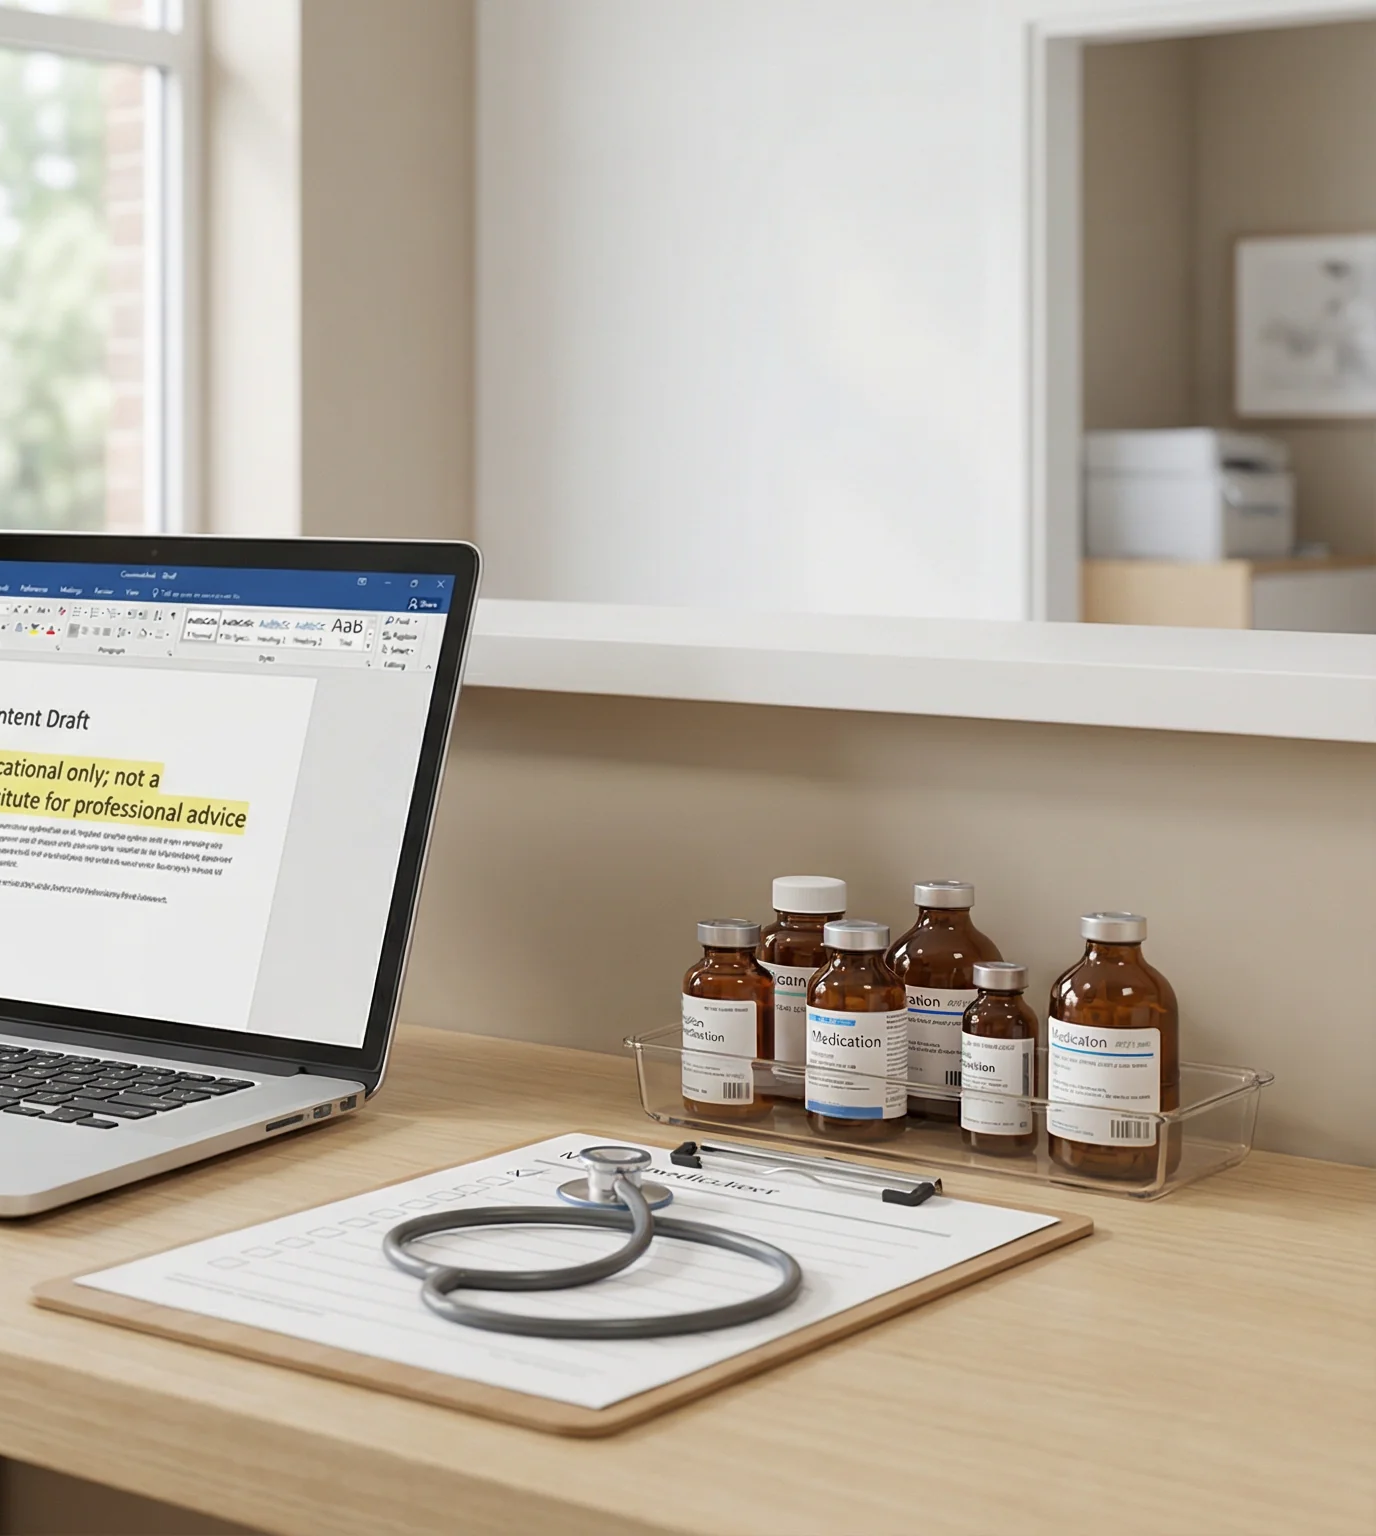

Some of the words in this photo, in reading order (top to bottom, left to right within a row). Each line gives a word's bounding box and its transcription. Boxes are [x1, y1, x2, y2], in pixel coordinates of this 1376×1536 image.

[46, 709, 91, 730] Draft
[66, 763, 110, 788] only;
[114, 769, 145, 788] not
[149, 773, 160, 788] a
[45, 791, 71, 812] for
[73, 795, 183, 823] professional
[186, 806, 247, 828] advice
[907, 994, 941, 1008] ation
[812, 1030, 882, 1049] Medication
